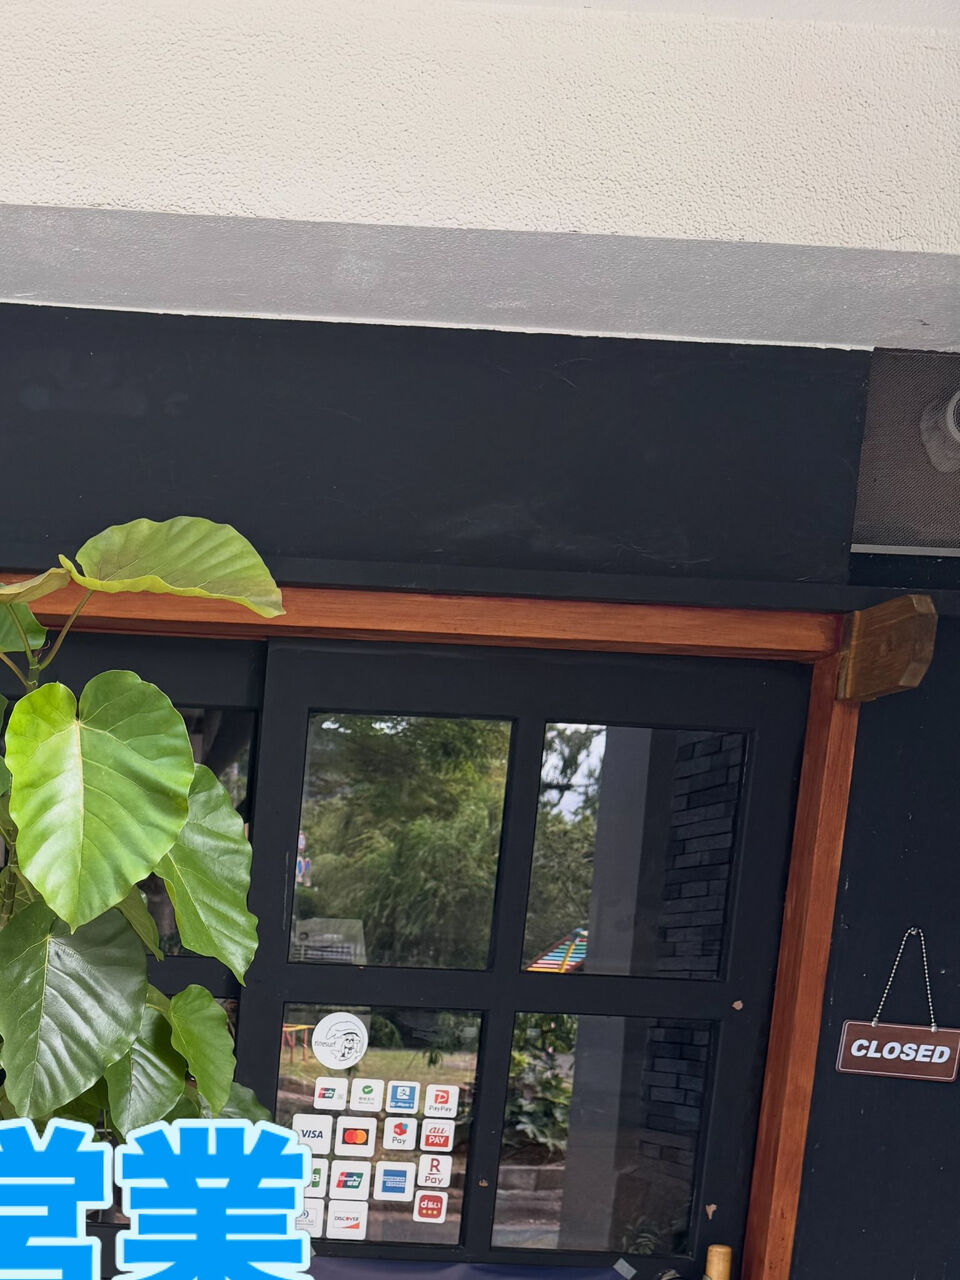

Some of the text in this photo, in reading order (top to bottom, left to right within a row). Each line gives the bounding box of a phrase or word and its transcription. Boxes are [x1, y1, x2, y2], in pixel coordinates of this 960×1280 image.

[850, 1038, 951, 1064] CLOSED
[301, 1129, 324, 1139] VISA
[392, 1136, 407, 1145] Pay
[428, 1136, 445, 1145] PAY
[424, 1175, 444, 1185] Pay
